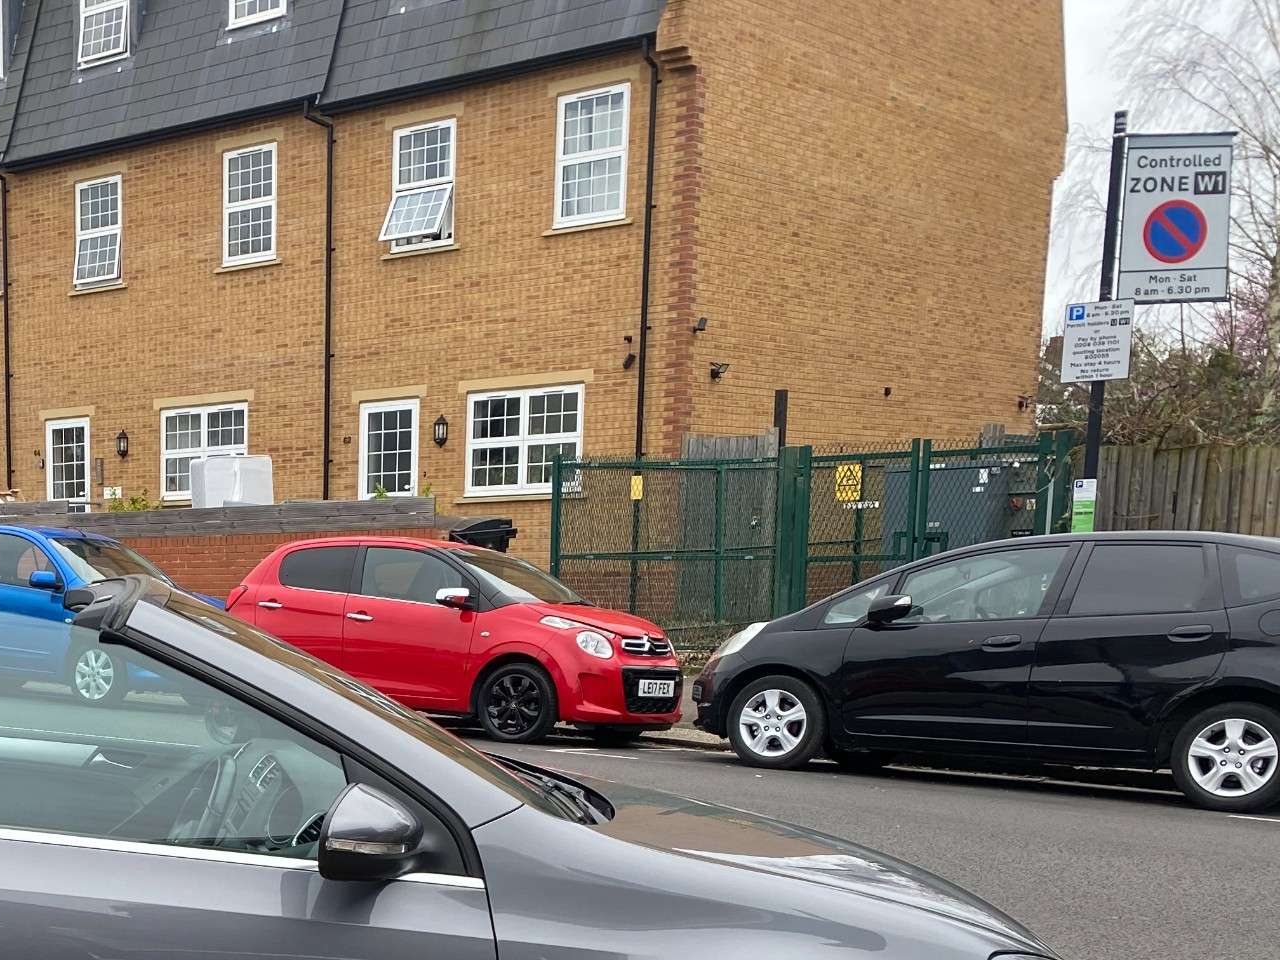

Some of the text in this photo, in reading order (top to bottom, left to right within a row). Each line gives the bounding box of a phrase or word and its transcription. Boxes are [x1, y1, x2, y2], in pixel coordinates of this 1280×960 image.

[1137, 154, 1222, 169] Controlled
[1130, 173, 1224, 193] ZONE W1
[1149, 274, 1170, 284] Mon
[1180, 274, 1197, 282] Sat
[1134, 287, 1141, 296] 8
[1167, 286, 1190, 294] 6.30
[1192, 287, 1210, 296] pm
[1072, 307, 1083, 320] P
[658, 682, 671, 695] FEX
